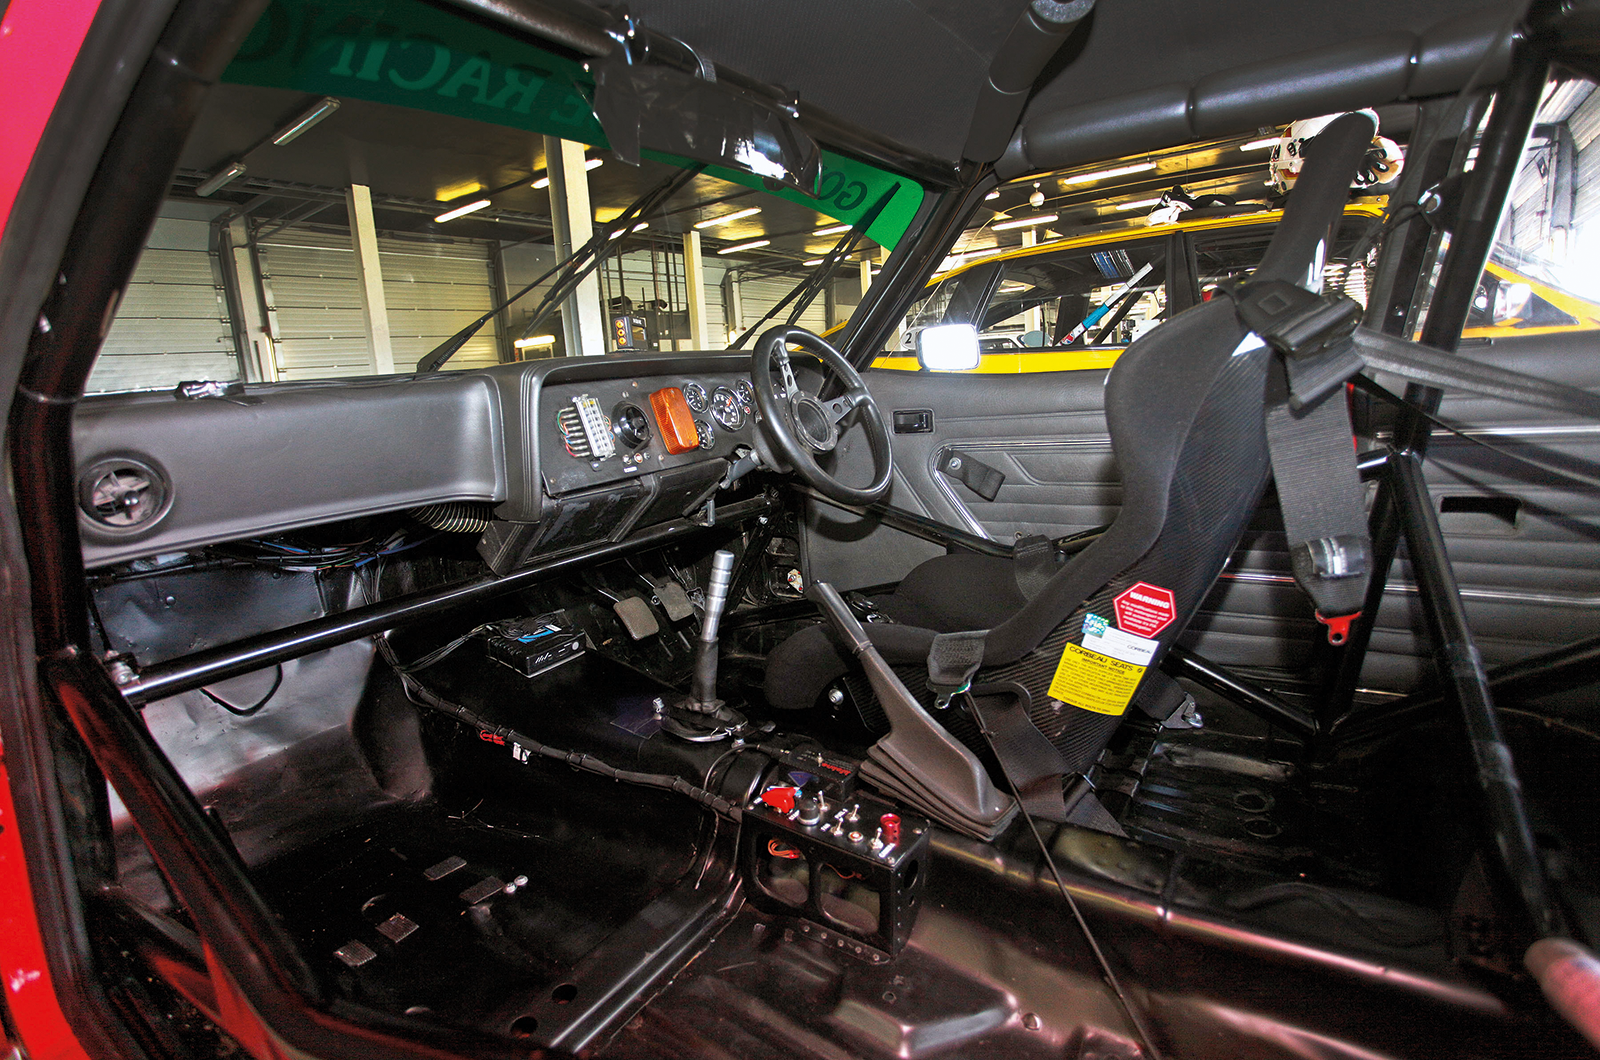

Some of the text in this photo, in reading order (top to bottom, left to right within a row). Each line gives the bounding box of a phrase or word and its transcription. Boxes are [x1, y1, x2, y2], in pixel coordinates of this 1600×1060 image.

[1130, 591, 1170, 609] WARNING
[1069, 646, 1107, 664] CORBEAU
[1110, 661, 1133, 671] SEATS
[1082, 659, 1107, 670] IMPORTANT
[1108, 667, 1125, 675] NOTICE
